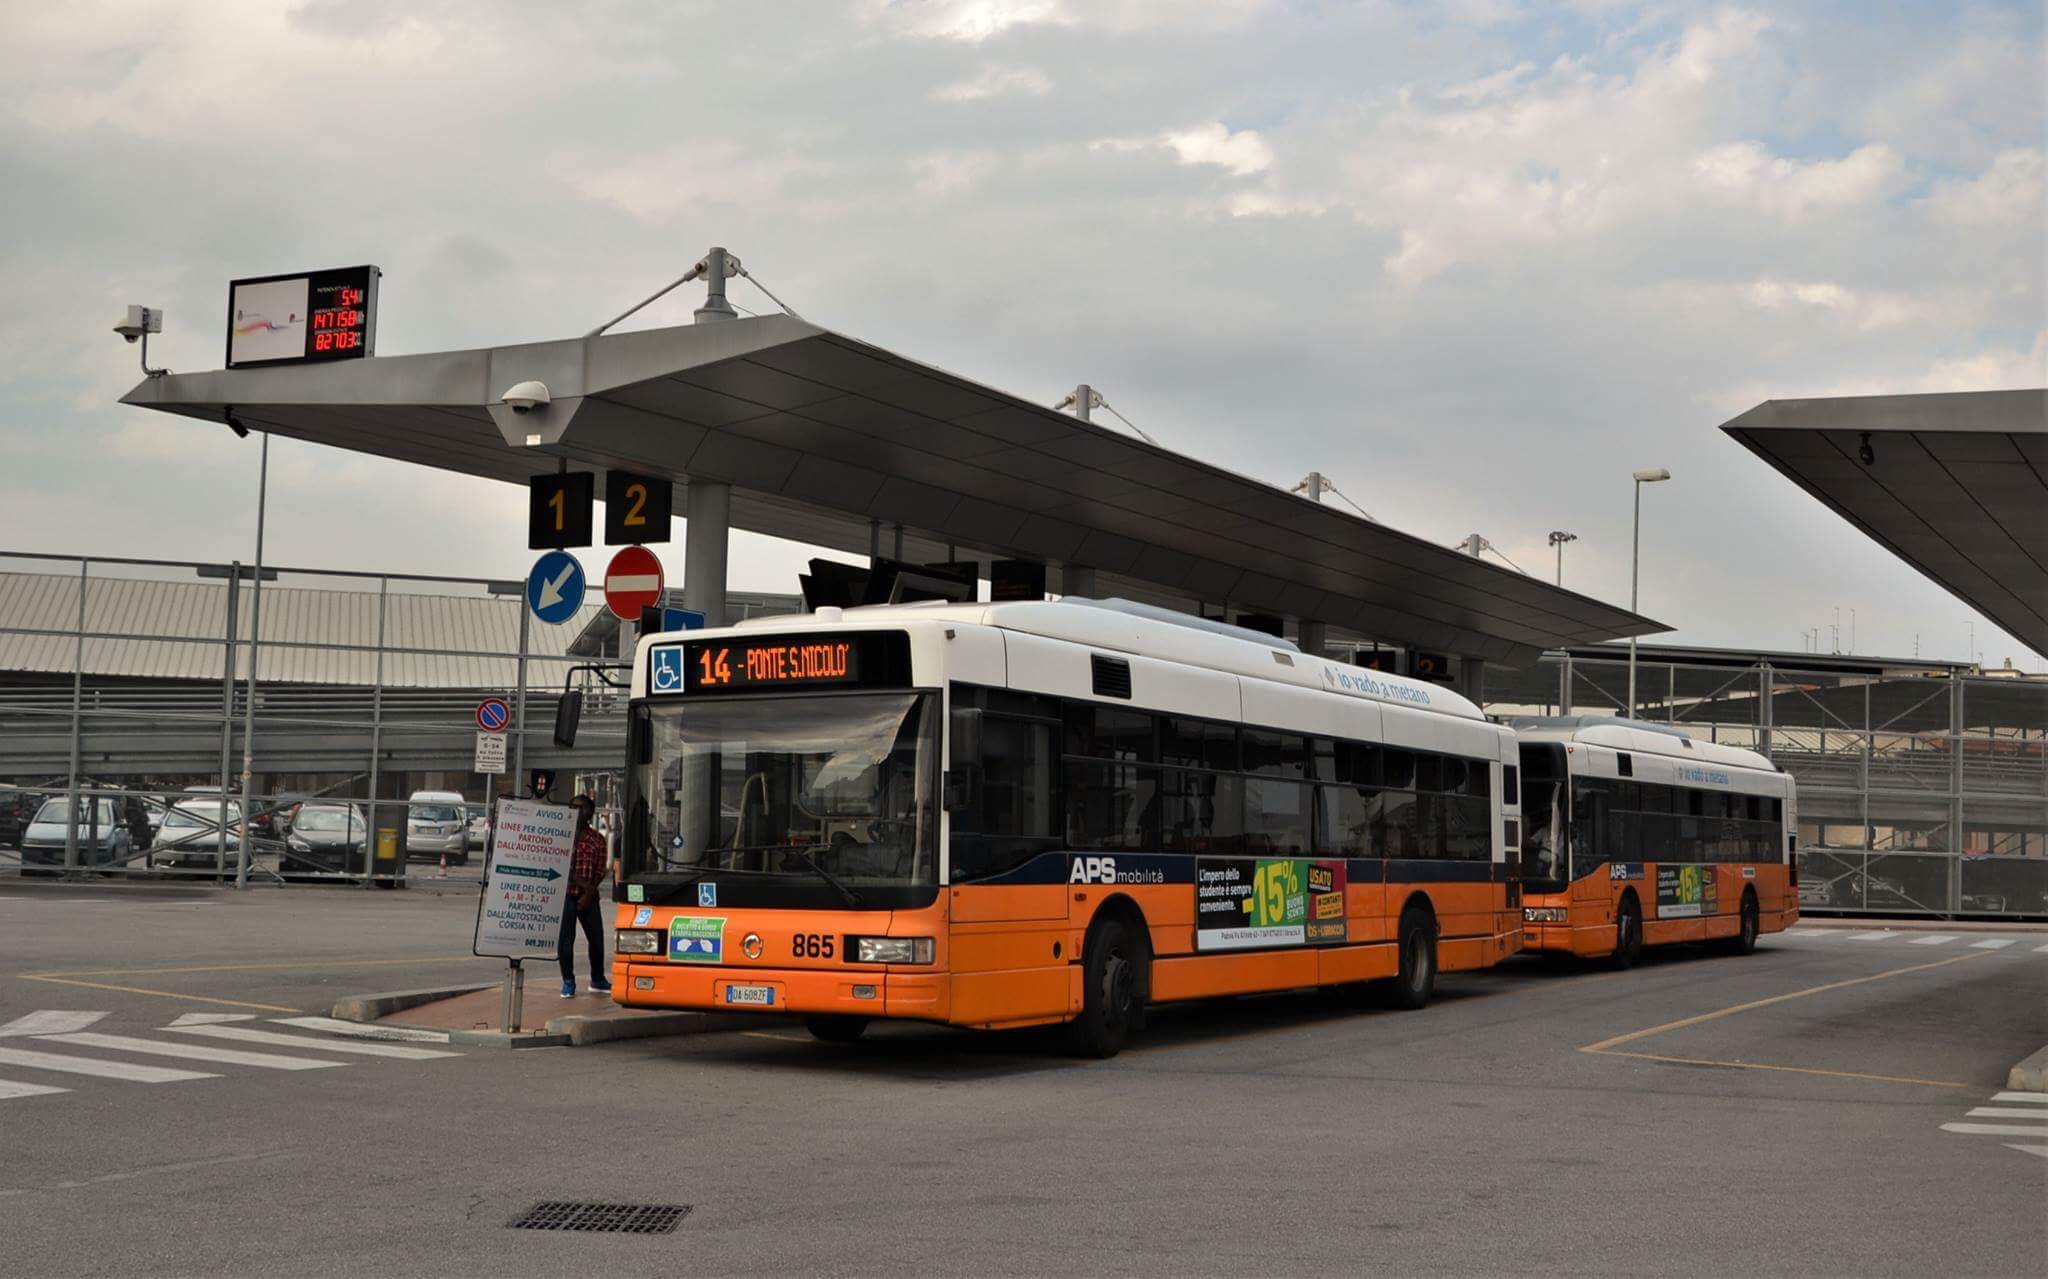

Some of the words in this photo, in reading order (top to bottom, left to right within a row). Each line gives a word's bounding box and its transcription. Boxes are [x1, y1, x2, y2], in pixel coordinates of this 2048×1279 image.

[316, 331, 355, 350] 82703
[549, 489, 564, 530] 1
[624, 484, 647, 525] 2
[700, 648, 731, 684] 14
[747, 647, 787, 680] PONTE
[1335, 667, 1351, 689] io
[1352, 673, 1380, 694] vado
[1381, 683, 1390, 697] a
[1390, 683, 1430, 704] metano
[536, 809, 564, 821] AVVISO
[500, 822, 521, 832] LINEE
[523, 825, 536, 834] PER
[537, 826, 572, 838] OSPEDALE
[518, 833, 553, 845] PARTONO
[497, 840, 570, 857] DALL'AUTOSTAZIONE
[1070, 857, 1116, 884] APS
[1117, 868, 1164, 883] mobilità
[1199, 868, 1225, 882] L'impero
[1225, 867, 1240, 880] dello
[1309, 868, 1332, 886] USATO
[1610, 865, 1627, 880] APS
[500, 882, 520, 892] LINEE
[522, 884, 534, 892] DEI
[536, 885, 556, 895] COLLI
[1200, 884, 1225, 898] studente
[1230, 884, 1252, 897] sempre
[504, 892, 510, 900] A
[540, 896, 550, 904] AT
[1200, 898, 1236, 912] conveniente.
[508, 902, 543, 912] PARTONO
[487, 910, 560, 924] DALL'AUTOSTAZIONE
[499, 920, 526, 930] CORSIA
[792, 934, 834, 958] 865
[733, 988, 742, 1000] DA
